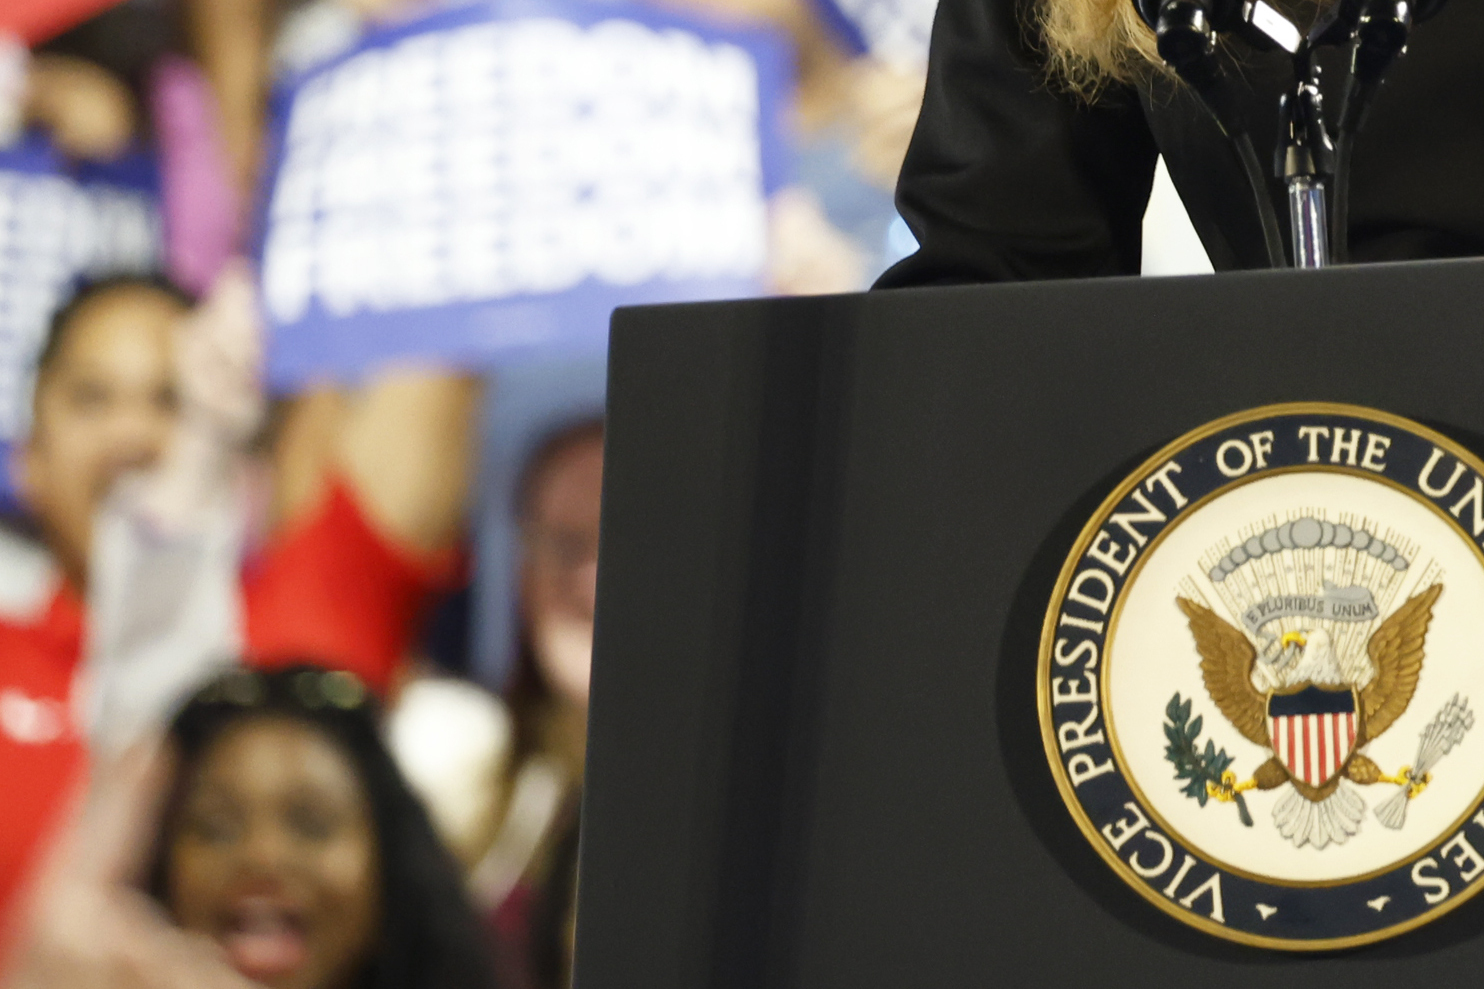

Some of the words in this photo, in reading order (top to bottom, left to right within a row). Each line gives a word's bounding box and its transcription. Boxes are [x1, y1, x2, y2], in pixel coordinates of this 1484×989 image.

[1216, 430, 1276, 477] OF
[1297, 425, 1393, 472] THE
[1052, 460, 1197, 787] PRESIDENT
[1246, 611, 1260, 625] E
[1257, 597, 1324, 617] PLURIBUS
[1332, 603, 1372, 616] UNUM
[1103, 800, 1226, 924] VICE
